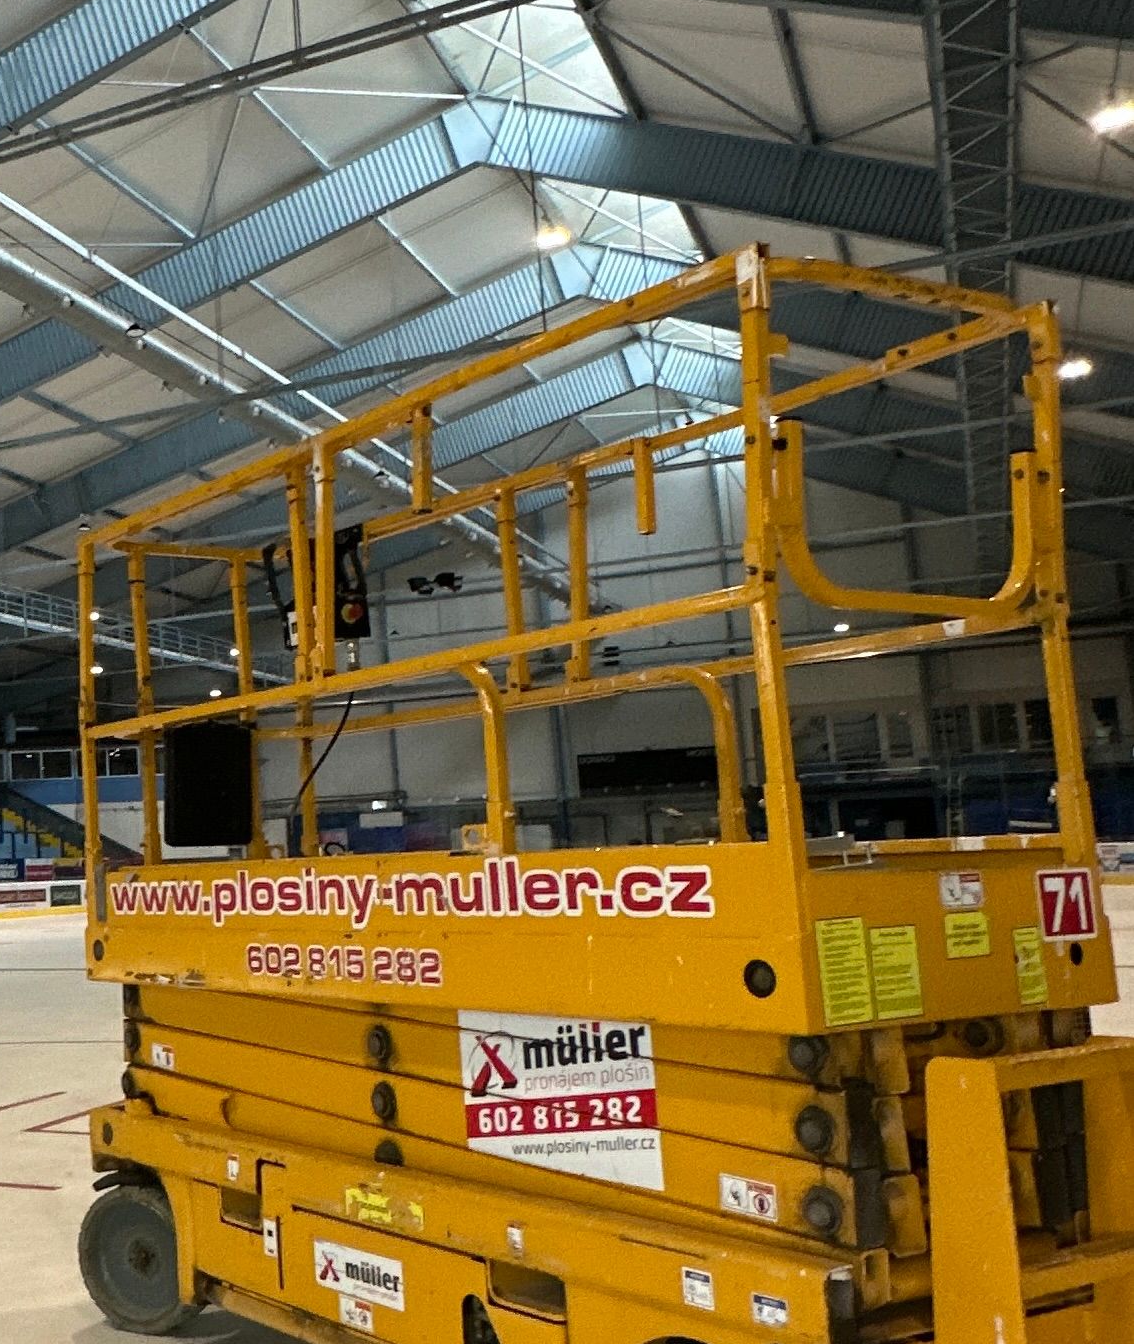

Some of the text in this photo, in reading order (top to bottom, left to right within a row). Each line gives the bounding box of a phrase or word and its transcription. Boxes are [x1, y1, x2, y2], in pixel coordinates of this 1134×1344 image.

[111, 859, 713, 927] www.plosiny-muller.cz
[1044, 875, 1088, 933] 71
[246, 944, 442, 986] 602 815 282
[523, 1022, 646, 1069] müller
[524, 1062, 650, 1094] pronájem plošin
[478, 1095, 643, 1134] 602 815 282
[512, 1136, 656, 1157] www.plosiny-muller.cz
[345, 1259, 400, 1293] müller
